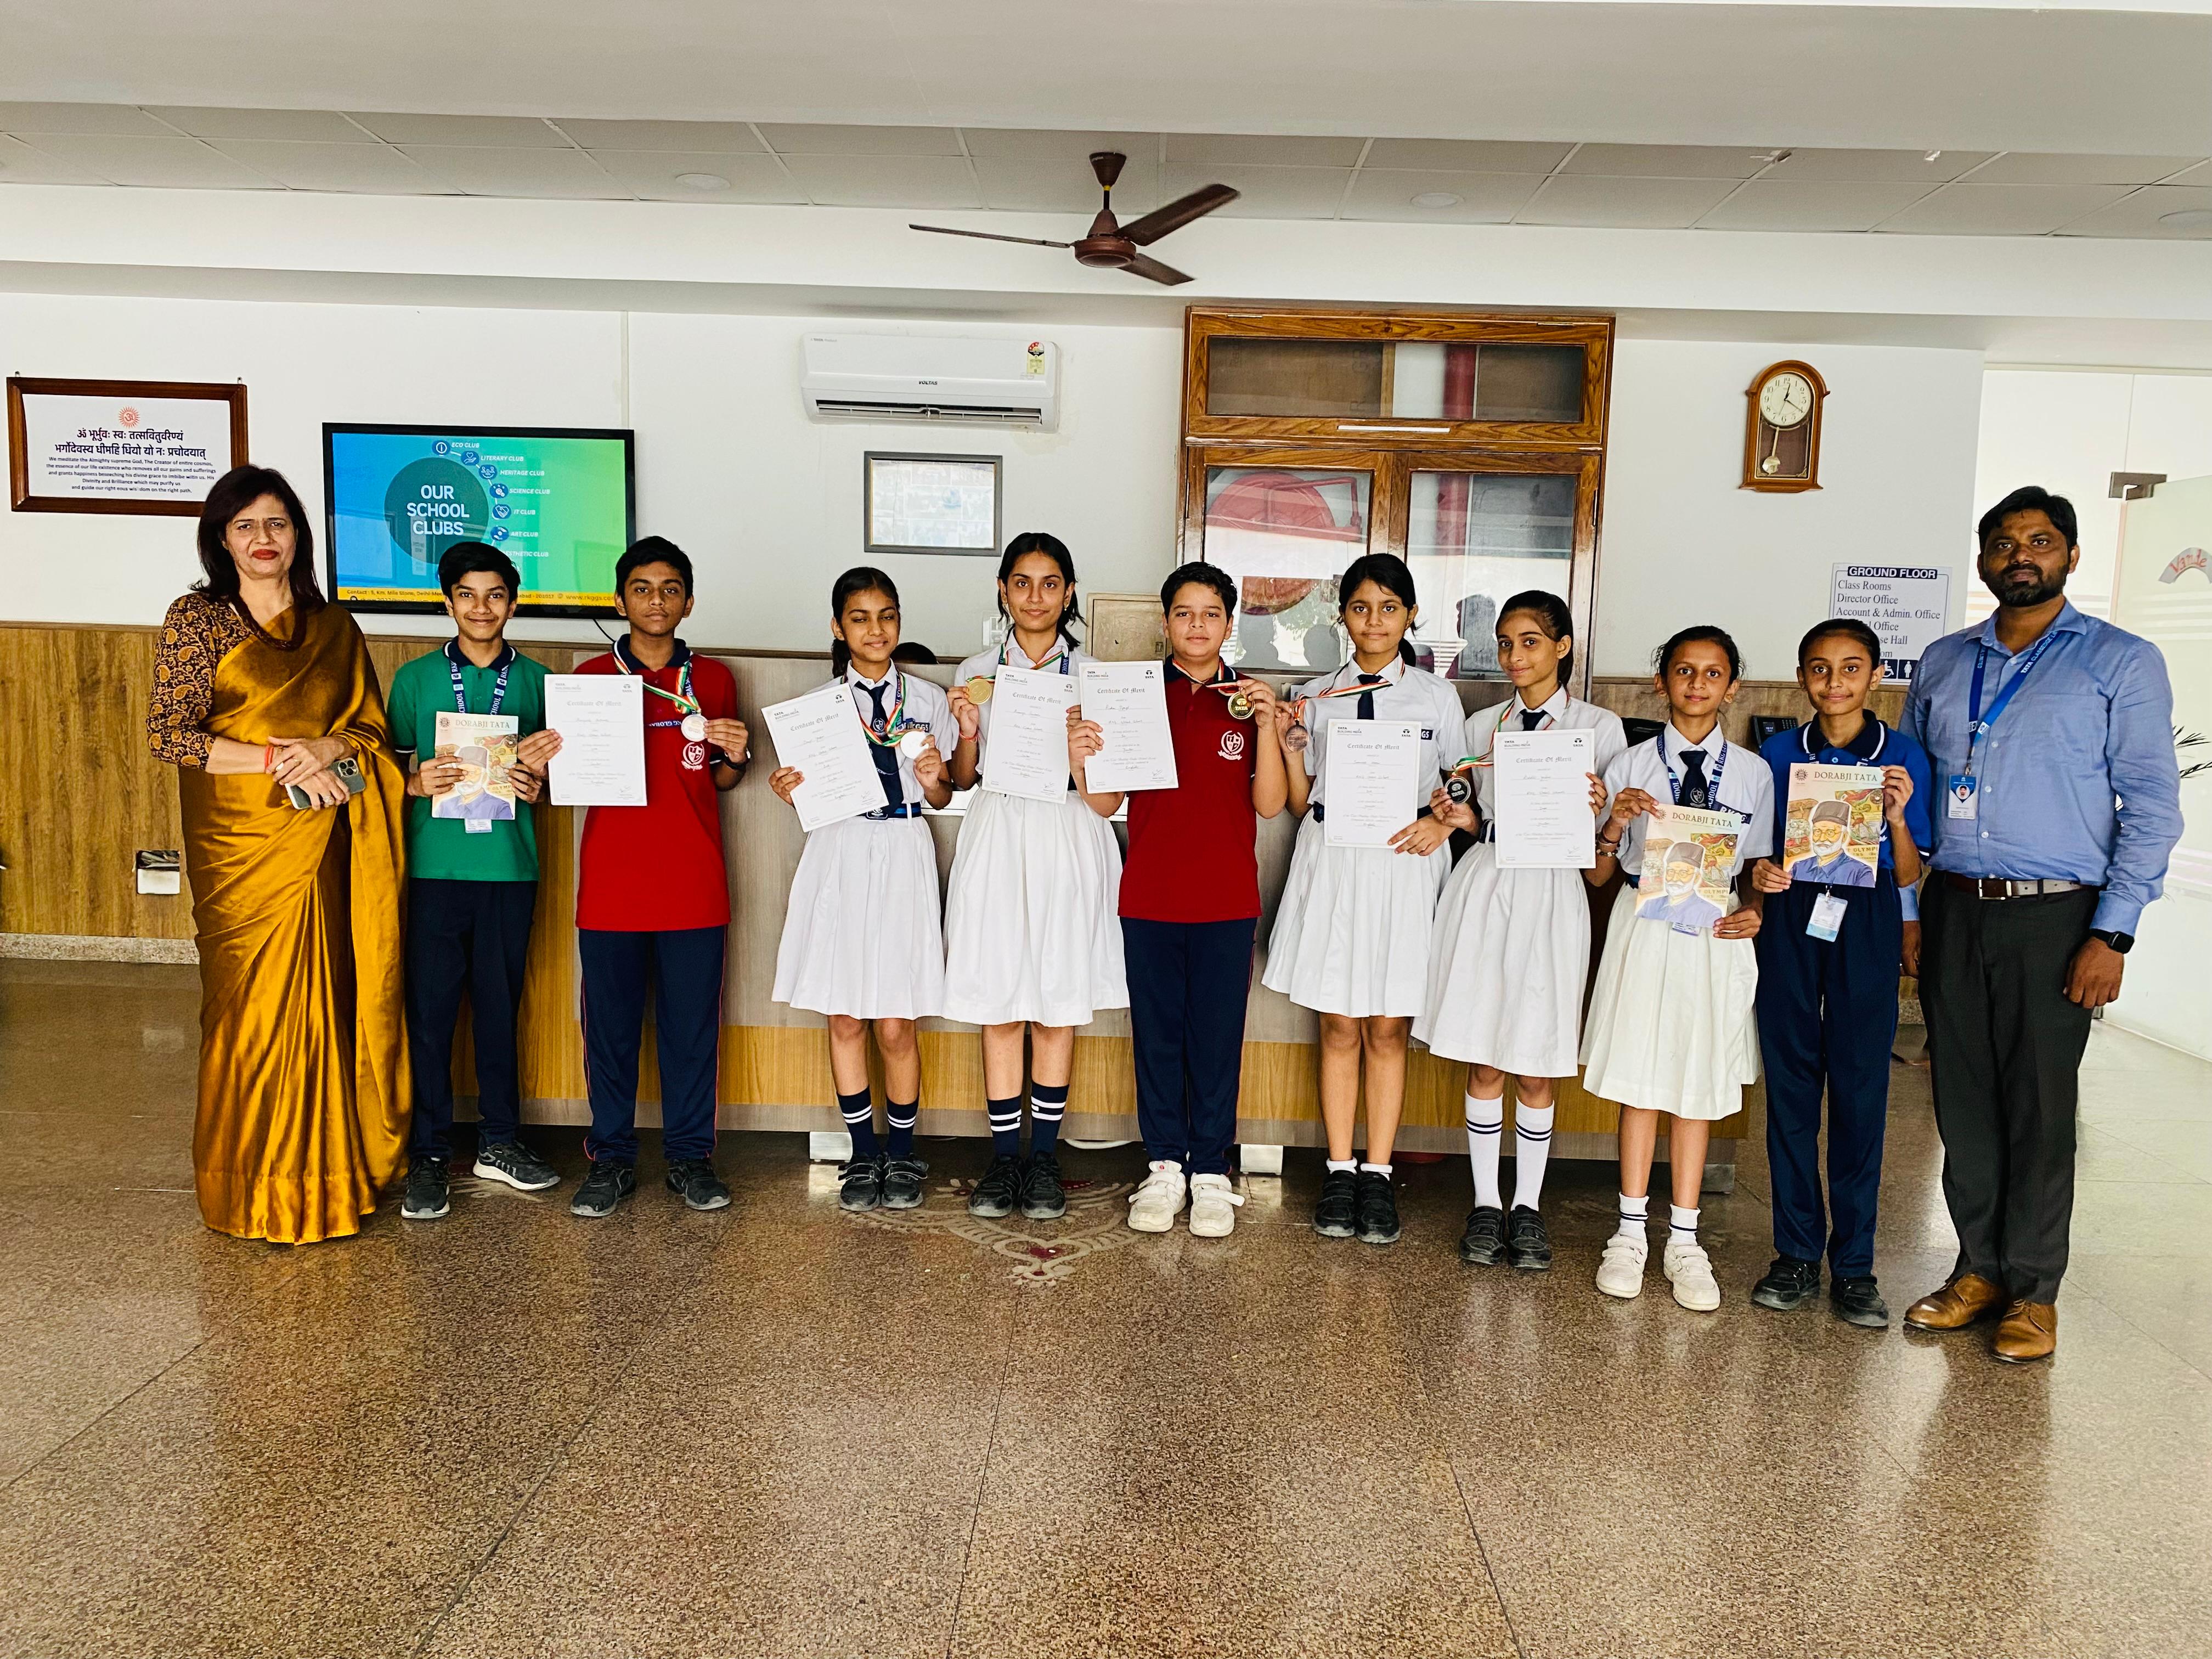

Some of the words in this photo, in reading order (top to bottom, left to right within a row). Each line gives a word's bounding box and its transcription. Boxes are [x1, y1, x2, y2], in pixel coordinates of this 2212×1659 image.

[112, 431, 126, 439] स्वः
[143, 444, 154, 455] यो
[156, 447, 165, 456] नः
[421, 485, 454, 499] OUR
[407, 503, 470, 518] SCHOOL
[413, 521, 464, 535] CLUBS
[1849, 567, 1897, 577] GROUND
[1900, 569, 1936, 579] FLOOR
[1838, 579, 1860, 590] Class
[1863, 580, 1892, 590] Rooms
[1837, 593, 1871, 603] Director
[1874, 594, 1899, 604] Office
[1836, 607, 1870, 617] Account
[1872, 608, 1880, 617] &
[1882, 608, 1912, 618] Admin.
[1915, 609, 1940, 619] Office
[1874, 621, 1899, 631] Office
[1891, 635, 1908, 645] Hall
[2020, 661, 2034, 674] TATA
[1013, 692, 1036, 701] Certificate
[456, 692, 466, 714] CHOOL
[456, 719, 488, 728] DORABJI
[790, 720, 815, 731] Certificate
[825, 713, 839, 722] Merit
[1814, 771, 1852, 781] DORABJI
[1854, 773, 1877, 782] TATA
[1673, 812, 1708, 823] DORABJI
[1711, 817, 1733, 827] TATA
